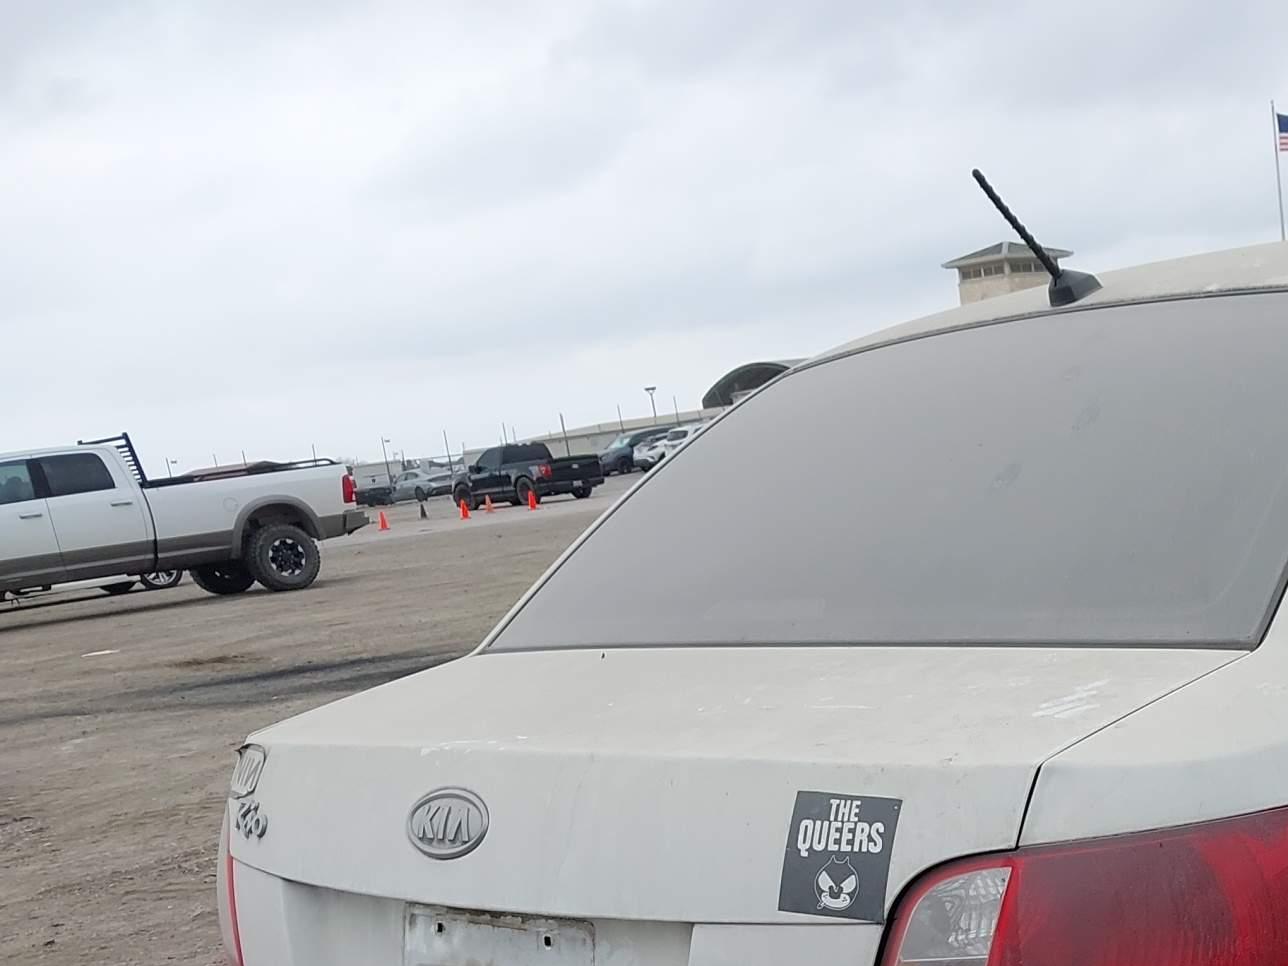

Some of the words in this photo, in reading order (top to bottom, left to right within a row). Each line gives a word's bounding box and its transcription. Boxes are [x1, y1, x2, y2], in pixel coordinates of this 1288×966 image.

[416, 803, 471, 842] KIA
[829, 798, 861, 822] THE
[797, 818, 885, 857] QUEERS
